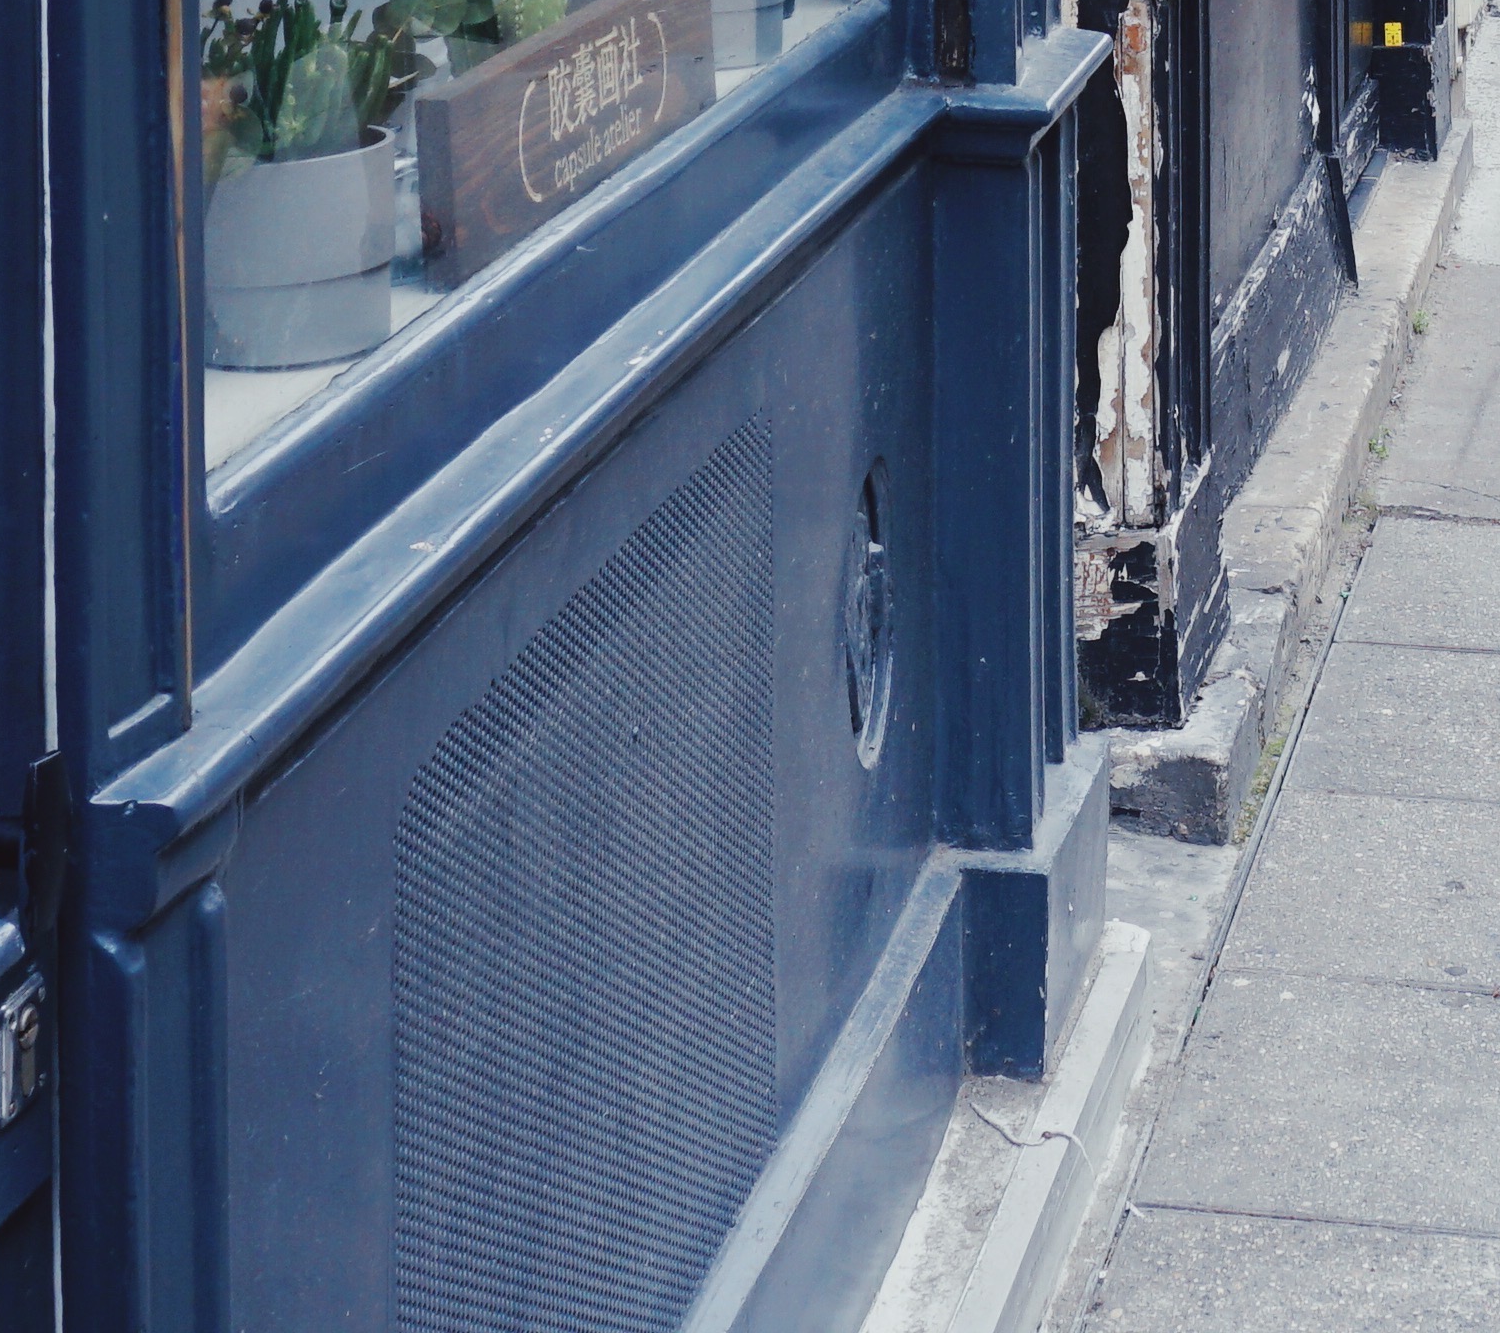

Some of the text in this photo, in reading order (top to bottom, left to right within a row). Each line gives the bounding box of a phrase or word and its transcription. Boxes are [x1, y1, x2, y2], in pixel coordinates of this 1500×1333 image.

[548, 16, 644, 142] 胶囊画社
[554, 105, 643, 193] capsule atelier
